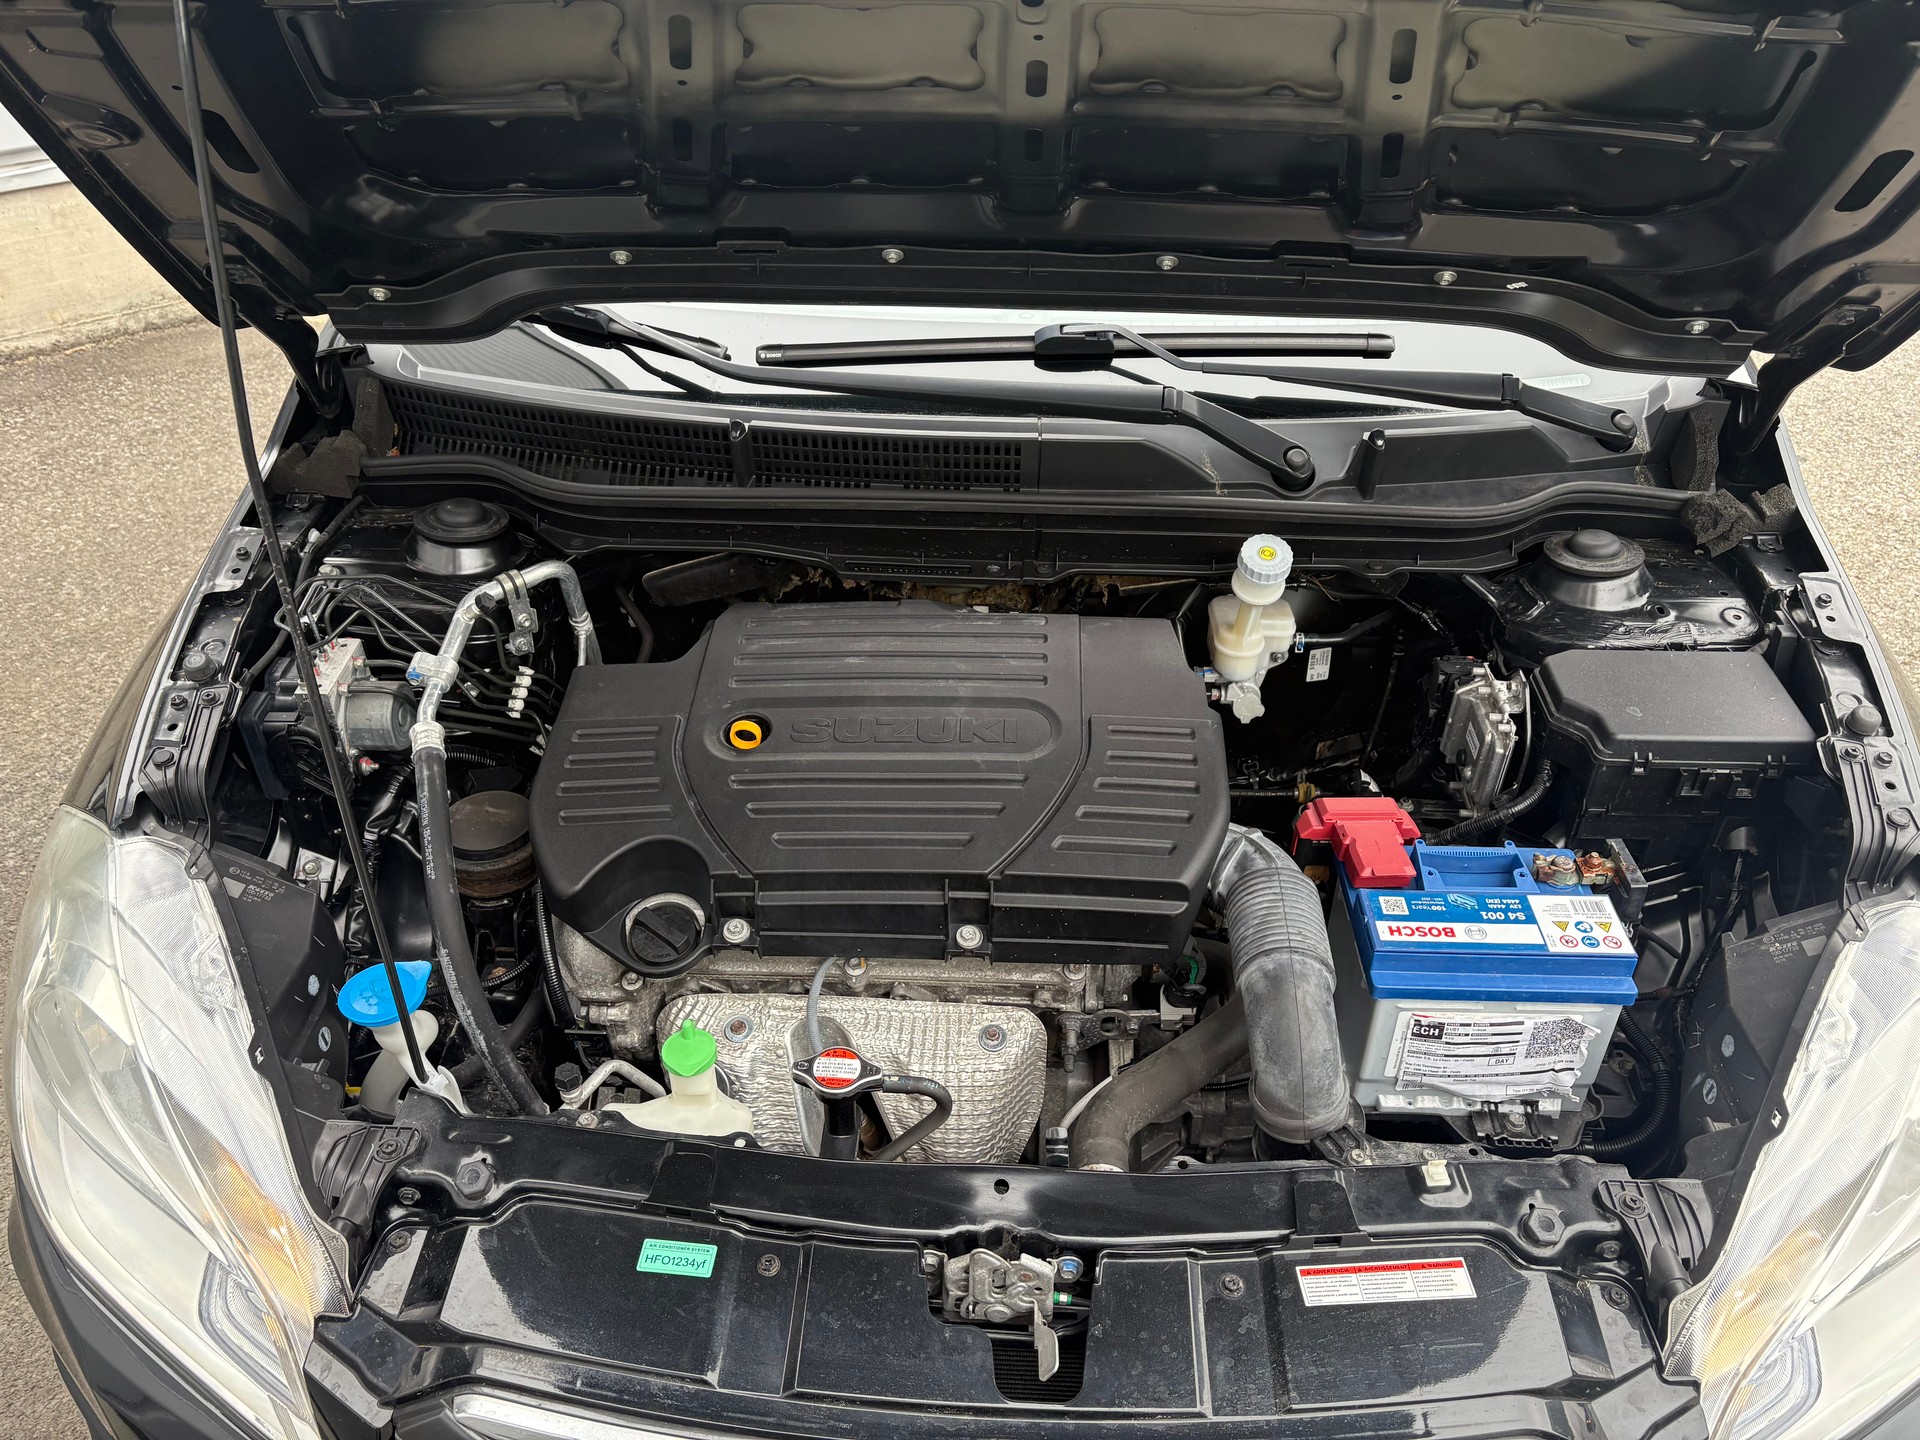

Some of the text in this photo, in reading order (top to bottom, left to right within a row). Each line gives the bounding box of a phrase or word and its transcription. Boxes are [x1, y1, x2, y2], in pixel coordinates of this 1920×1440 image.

[790, 717, 1018, 744] SUZUKI
[246, 889, 272, 900] 100-17733
[1480, 911, 1526, 920] S4 001
[1388, 925, 1456, 938] BOSCH
[1413, 1026, 1439, 1036] ECH
[645, 1254, 707, 1270] HFO1234yf
